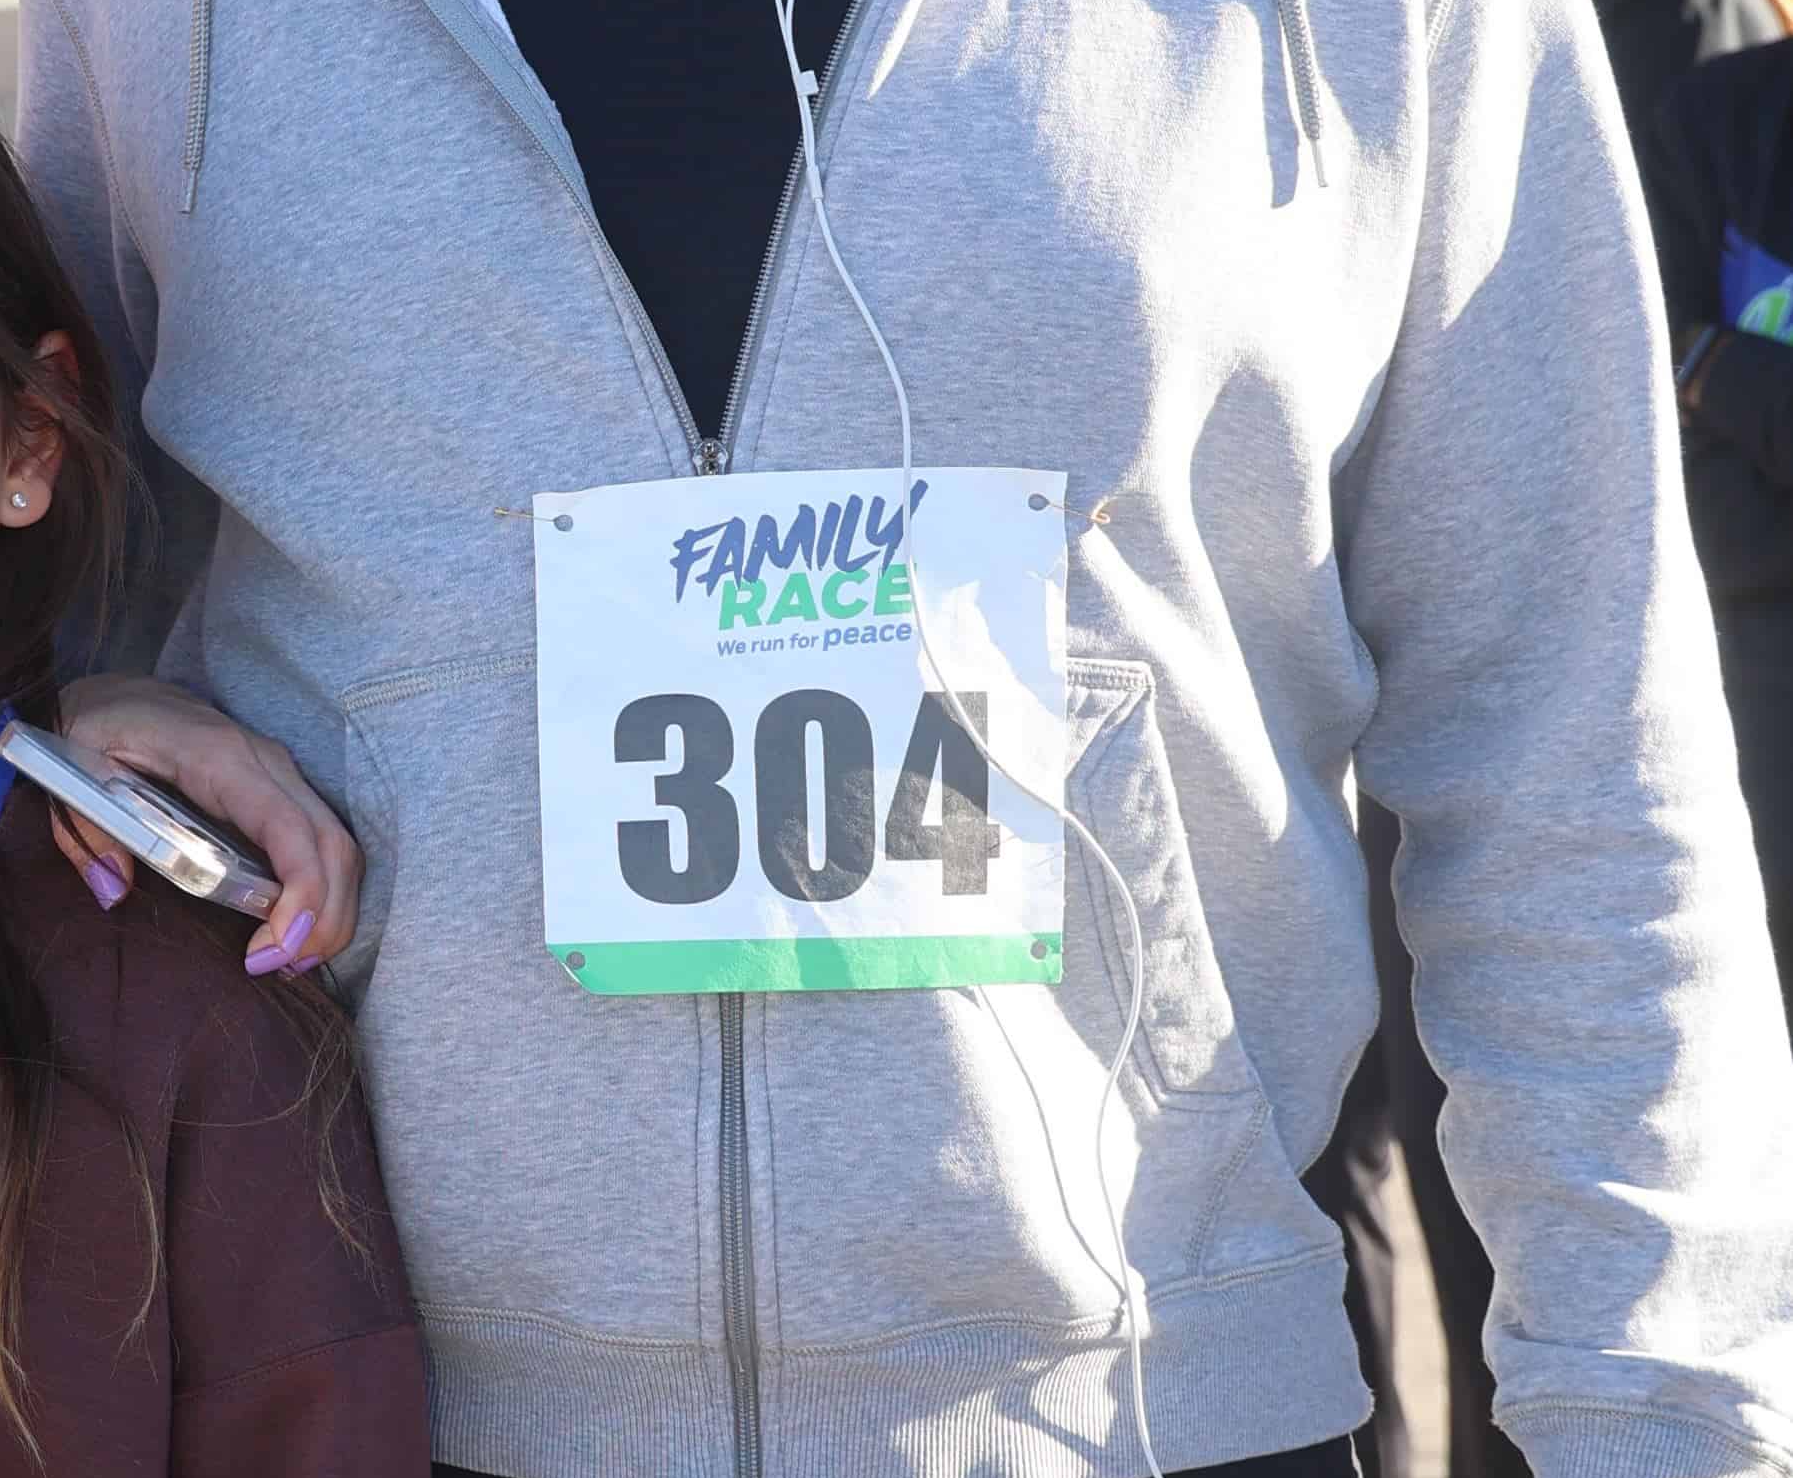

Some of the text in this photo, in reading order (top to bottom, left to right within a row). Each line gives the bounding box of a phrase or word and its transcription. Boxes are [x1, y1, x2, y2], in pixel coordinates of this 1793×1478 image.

[670, 479, 928, 603] FAMILY
[717, 622, 912, 656] We run for peace
[718, 563, 917, 631] RACE
[614, 688, 1000, 905] 304
